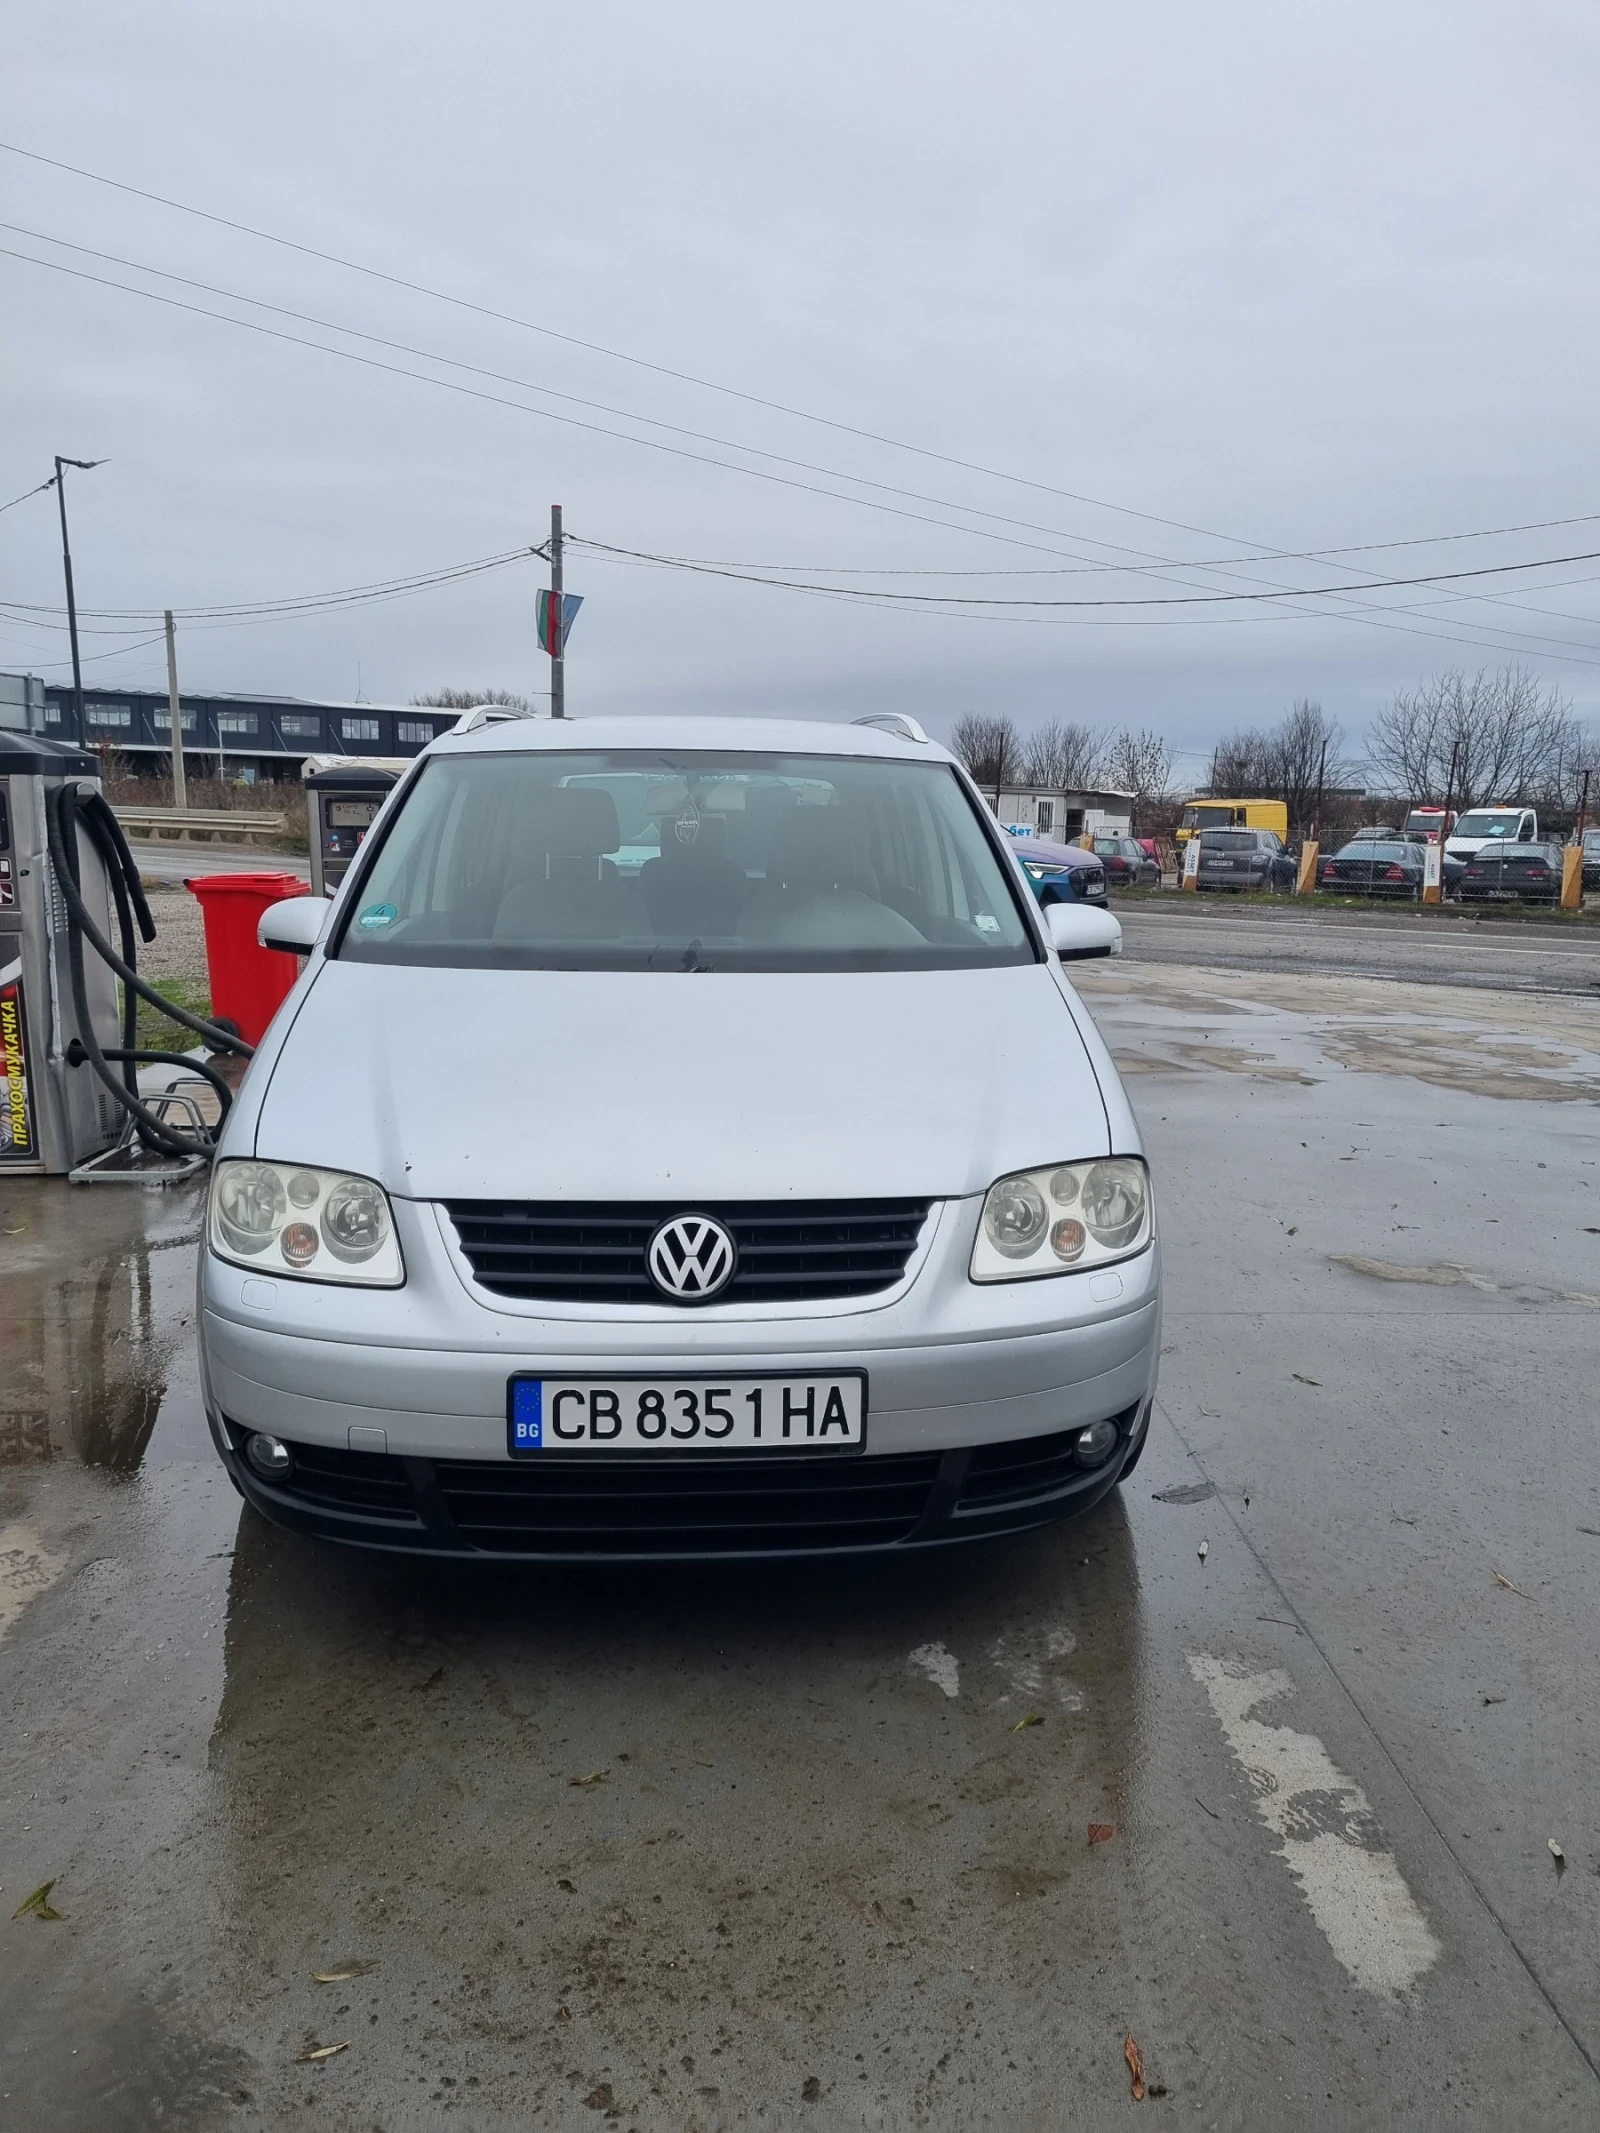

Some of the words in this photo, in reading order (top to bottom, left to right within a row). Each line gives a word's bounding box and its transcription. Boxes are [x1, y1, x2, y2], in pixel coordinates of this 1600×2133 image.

[374, 905, 386, 916] 4
[1, 1000, 28, 1146] ПРАХОСМУКАЧКА
[552, 1389, 622, 1440] CB
[636, 1387, 763, 1440] 8351
[782, 1385, 850, 1438] HA
[517, 1423, 539, 1438] BG
